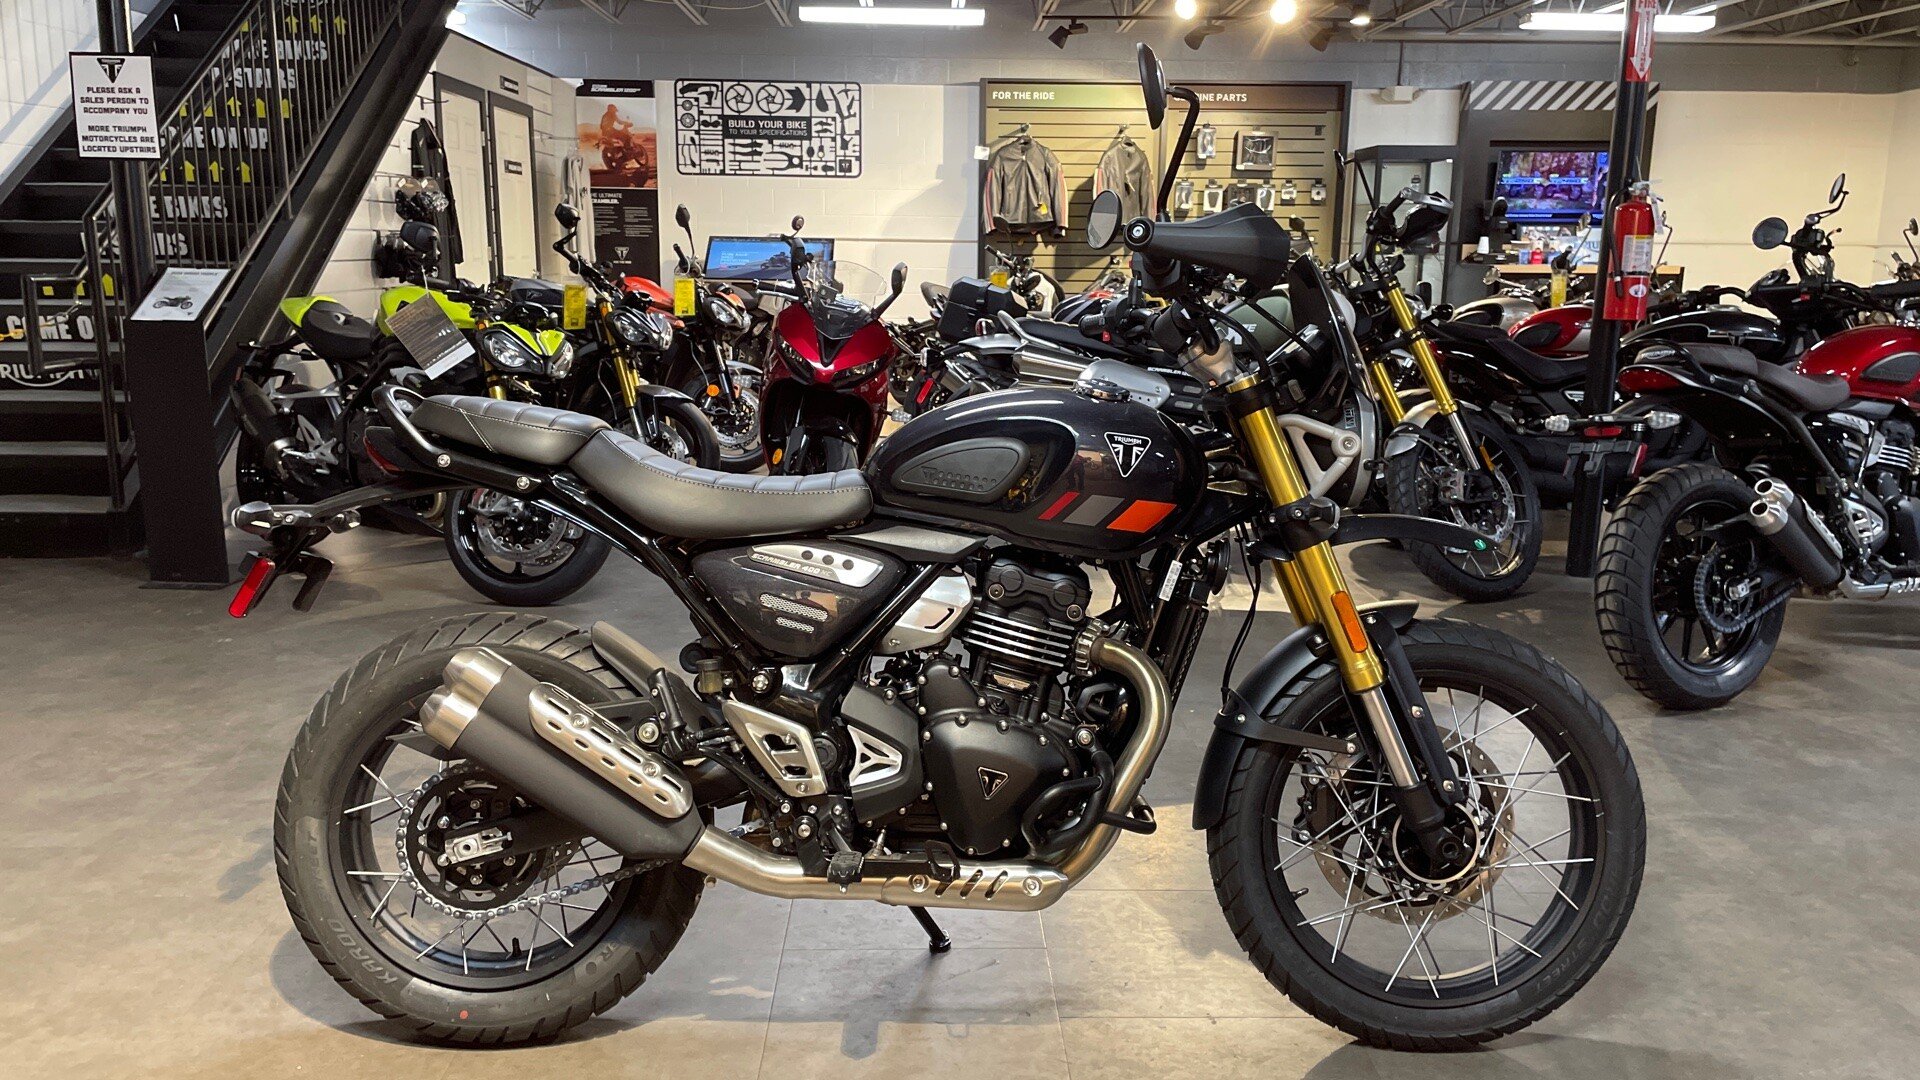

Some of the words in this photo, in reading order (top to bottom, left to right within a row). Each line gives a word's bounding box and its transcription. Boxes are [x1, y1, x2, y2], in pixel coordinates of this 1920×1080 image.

[992, 91, 1011, 100] FOR
[1012, 91, 1032, 100] THE
[1033, 91, 1055, 101] RIDE
[1216, 93, 1248, 102] PARTS
[112, 125, 147, 133] TRIUMPH
[728, 119, 755, 128] BUILD
[758, 120, 783, 129] YOUR
[786, 120, 807, 129] BIKE
[759, 129, 808, 137] SPECIFICATIONS
[1113, 435, 1142, 446] TRIUMPH
[751, 553, 802, 570] SCRAMBLER
[801, 565, 821, 574] 400
[326, 919, 399, 984] KAROO
